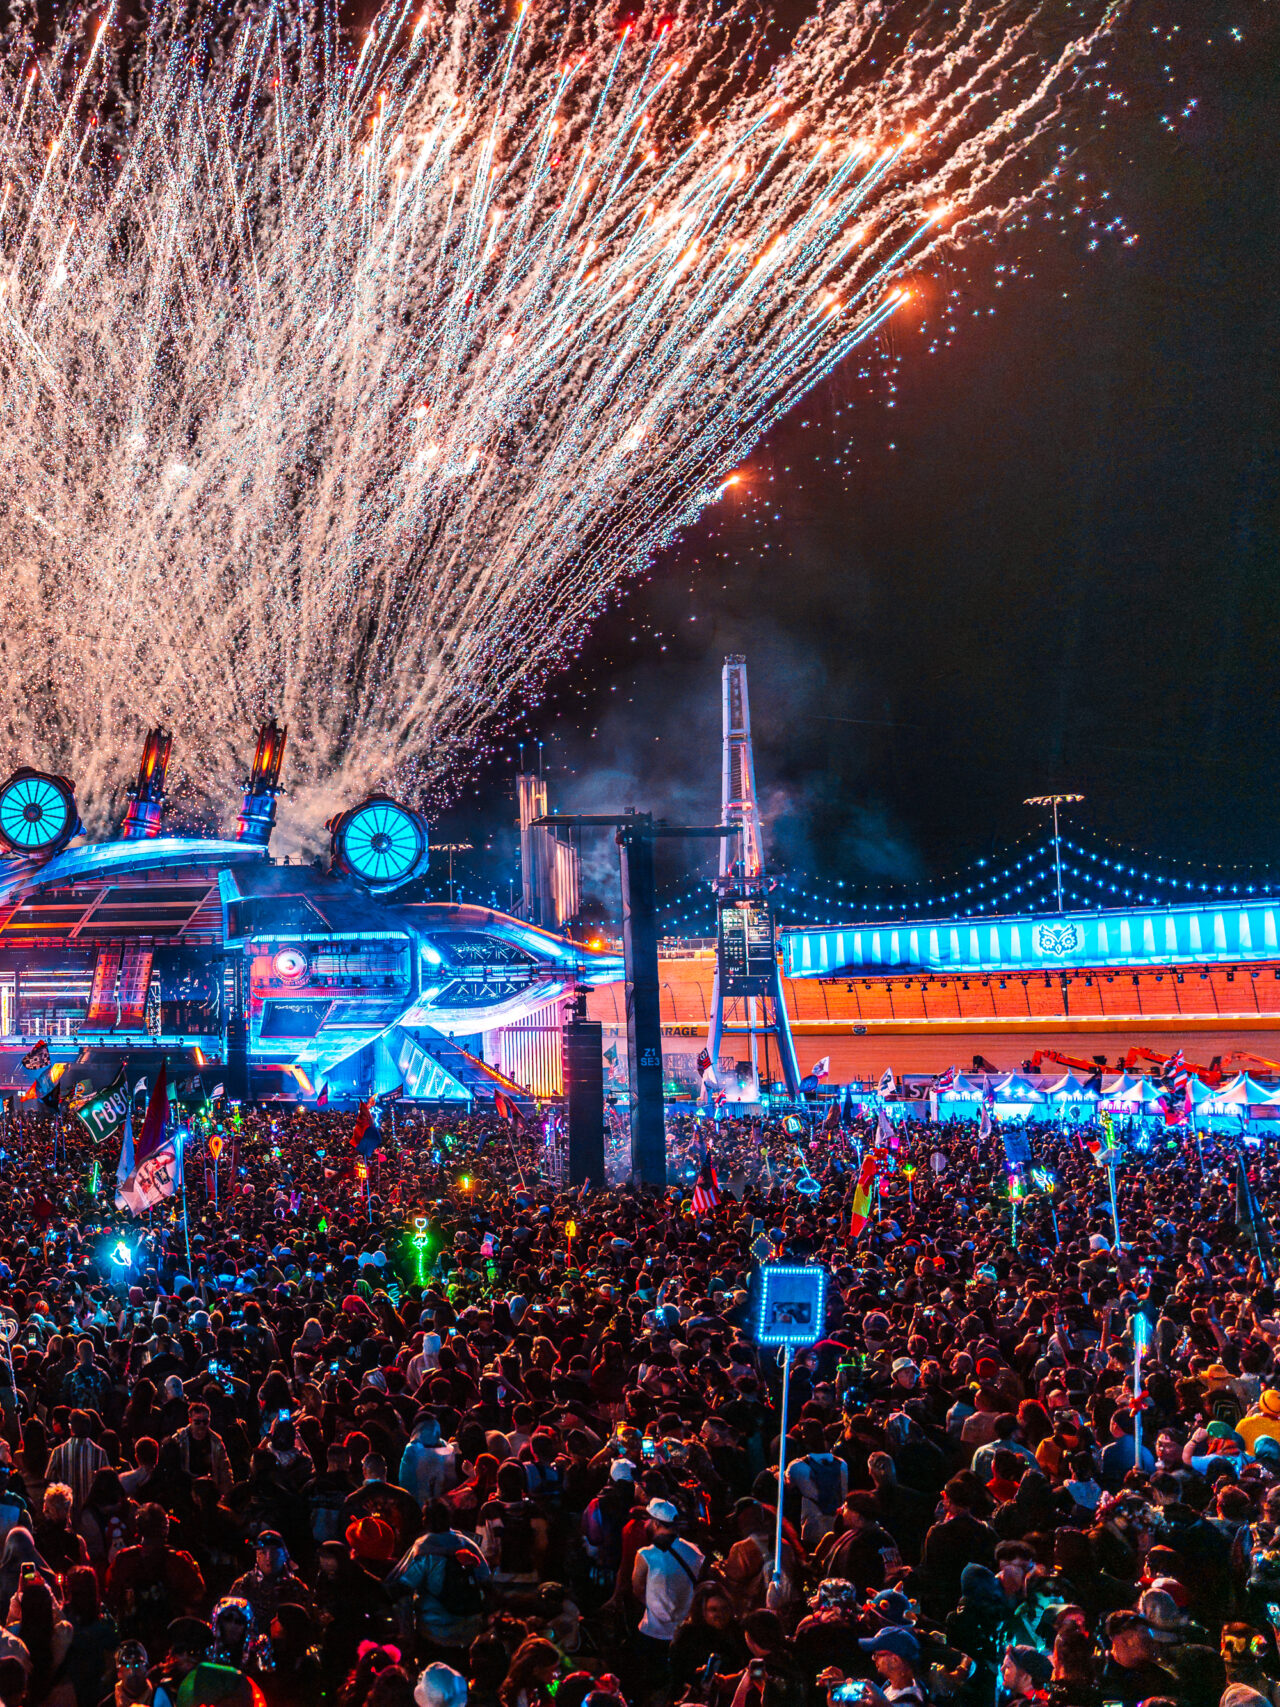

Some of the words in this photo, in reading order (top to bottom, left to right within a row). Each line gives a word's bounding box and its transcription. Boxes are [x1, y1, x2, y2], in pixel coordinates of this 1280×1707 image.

[661, 1027, 698, 1036] RAGE
[644, 1048, 655, 1056] Z1
[640, 1057, 660, 1066] SE3
